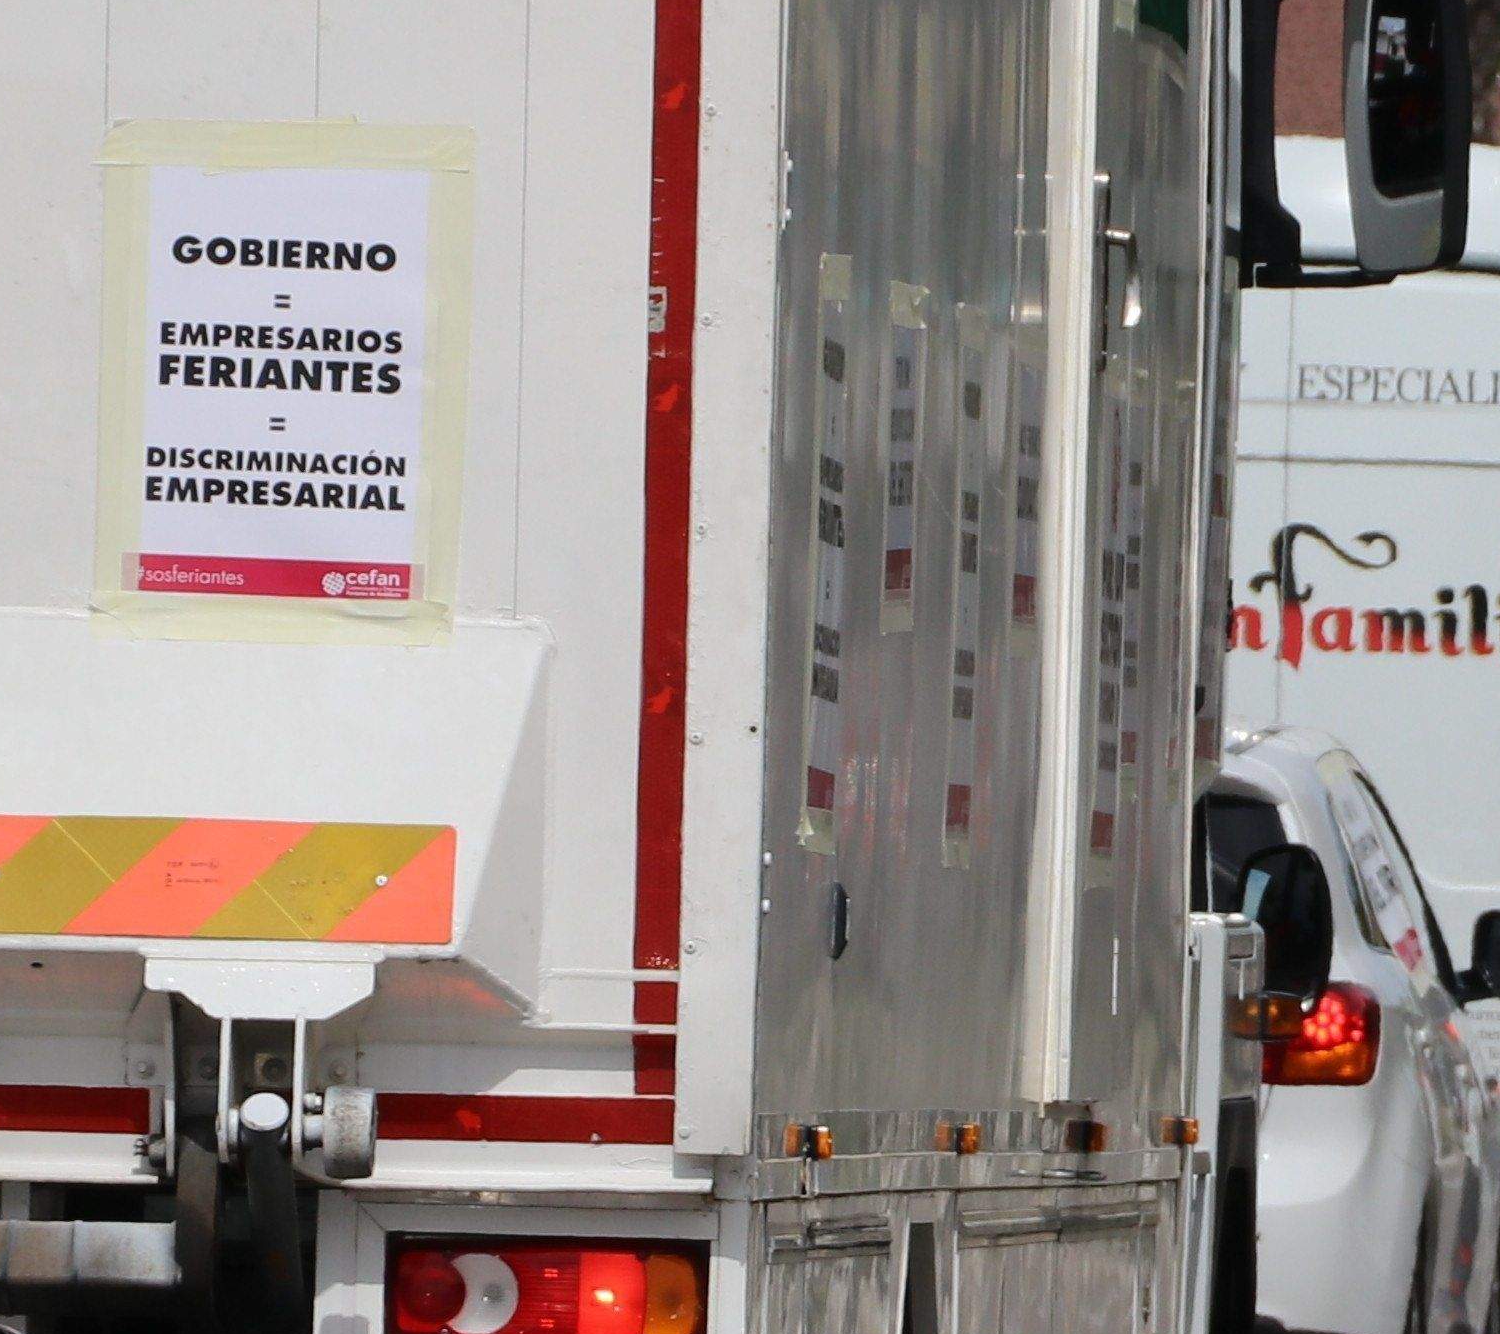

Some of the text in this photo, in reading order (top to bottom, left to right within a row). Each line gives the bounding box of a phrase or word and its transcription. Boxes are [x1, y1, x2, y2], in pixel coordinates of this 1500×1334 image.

[172, 235, 396, 272] GOBIERNO
[161, 322, 402, 354] EMPRESARIOS
[159, 354, 401, 395] FERIANTES
[147, 446, 406, 477] DISCRIMINACIÓN
[145, 476, 405, 511] EMPRESARIAL
[136, 564, 244, 585] #sosferiantes
[345, 569, 400, 586] cefan
